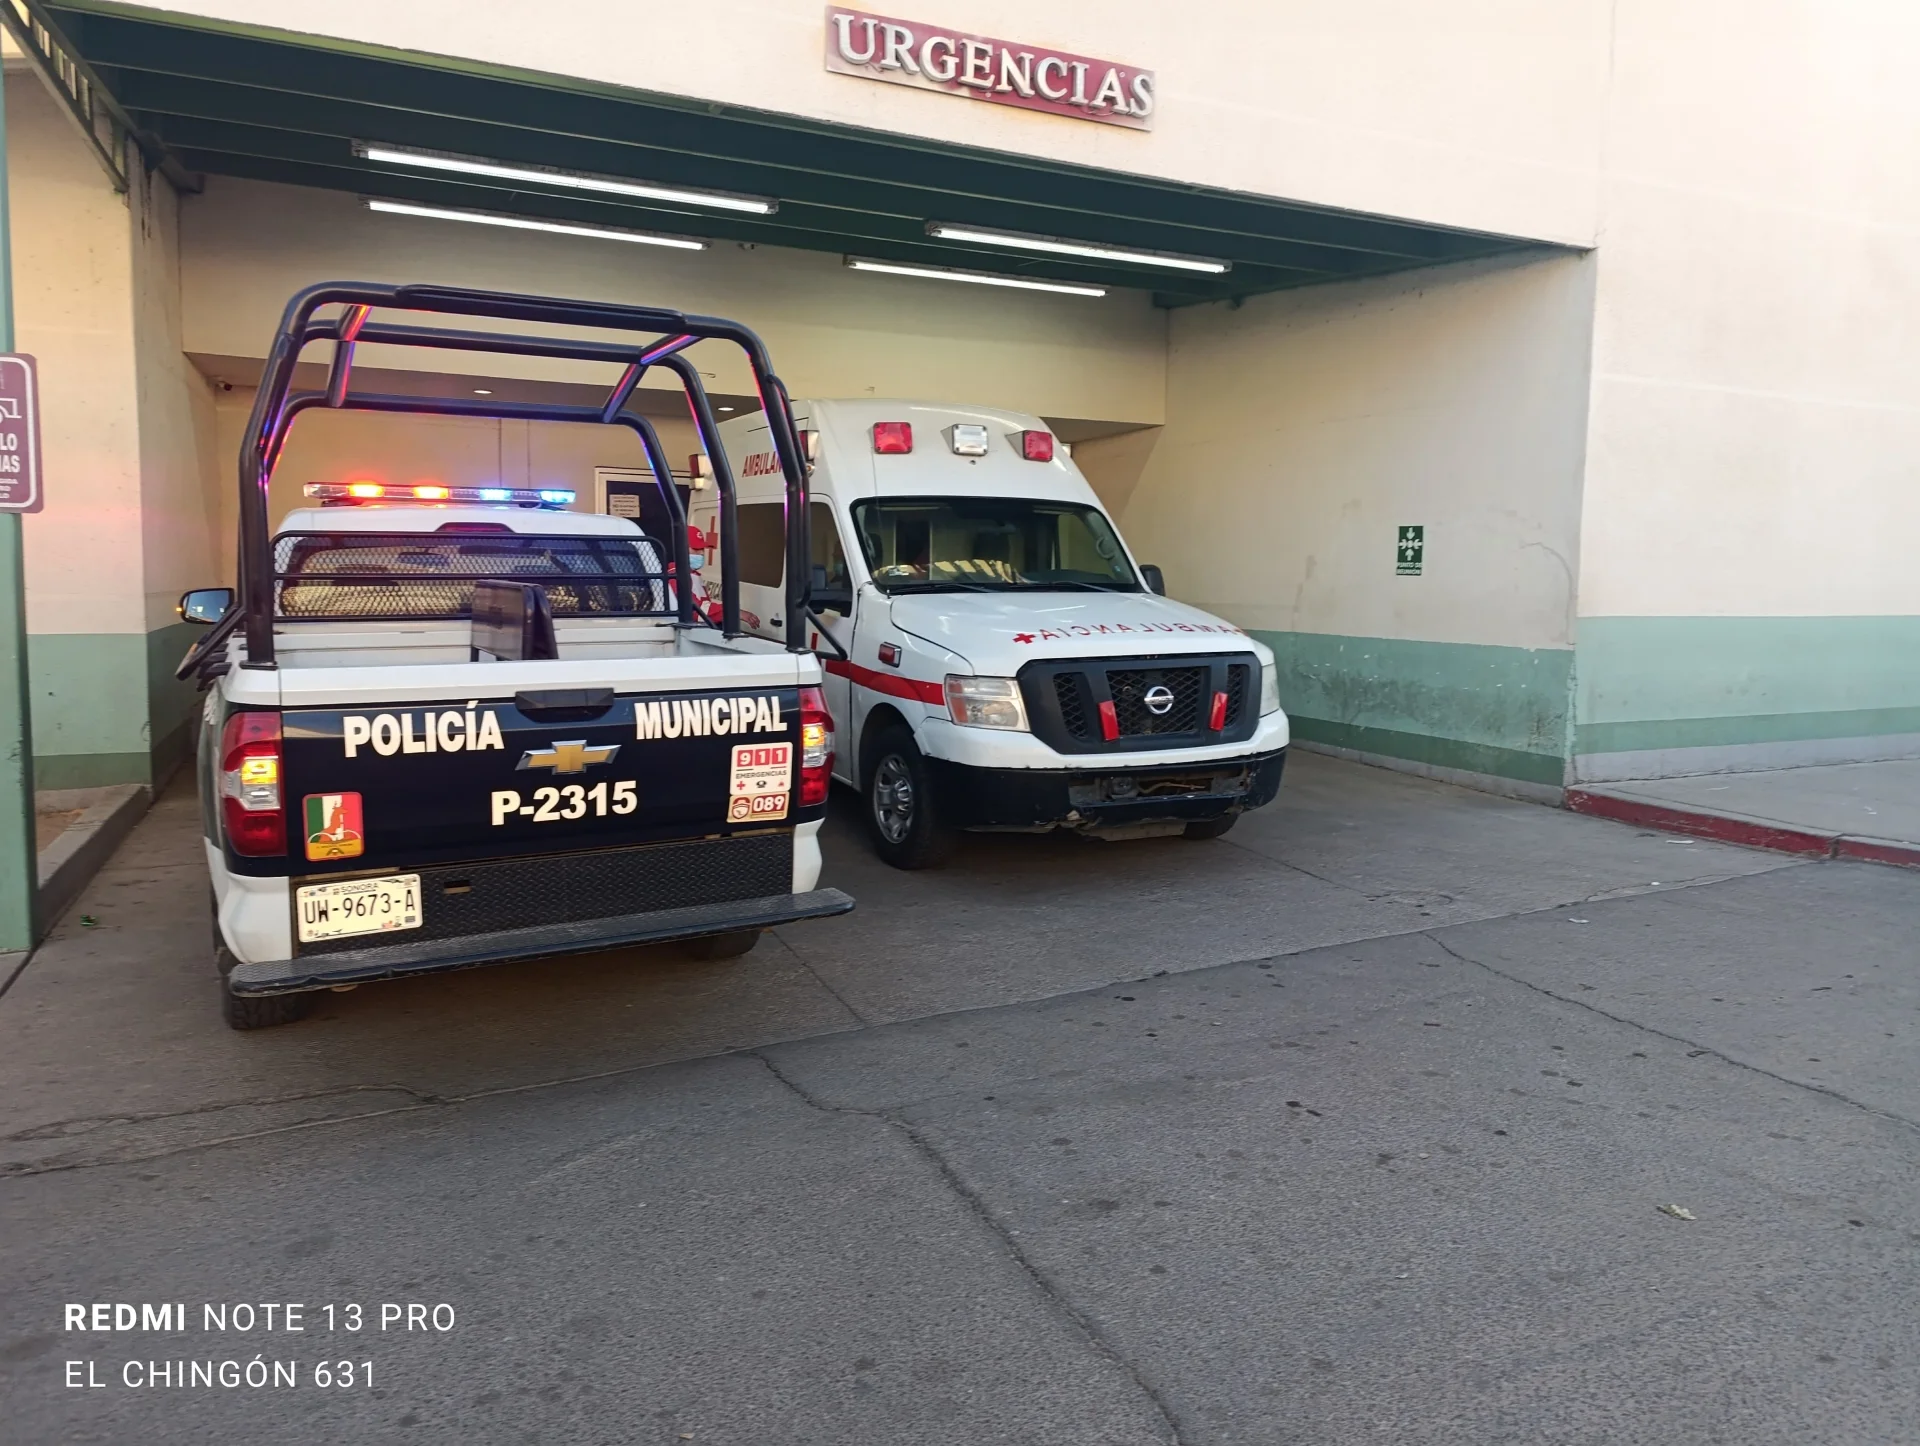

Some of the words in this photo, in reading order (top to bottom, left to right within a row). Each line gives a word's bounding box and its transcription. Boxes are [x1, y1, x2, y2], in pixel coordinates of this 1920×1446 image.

[832, 13, 1154, 118] URGENCIAS
[343, 701, 505, 757] POLICÍA
[635, 696, 787, 740] MUNICIPAL
[739, 748, 785, 766] 911
[735, 769, 788, 780] EMERGENCIAS
[491, 781, 638, 826] P-2315
[752, 795, 786, 812] 089
[341, 882, 379, 893] SONORA
[304, 889, 416, 924] UW-9673-A
